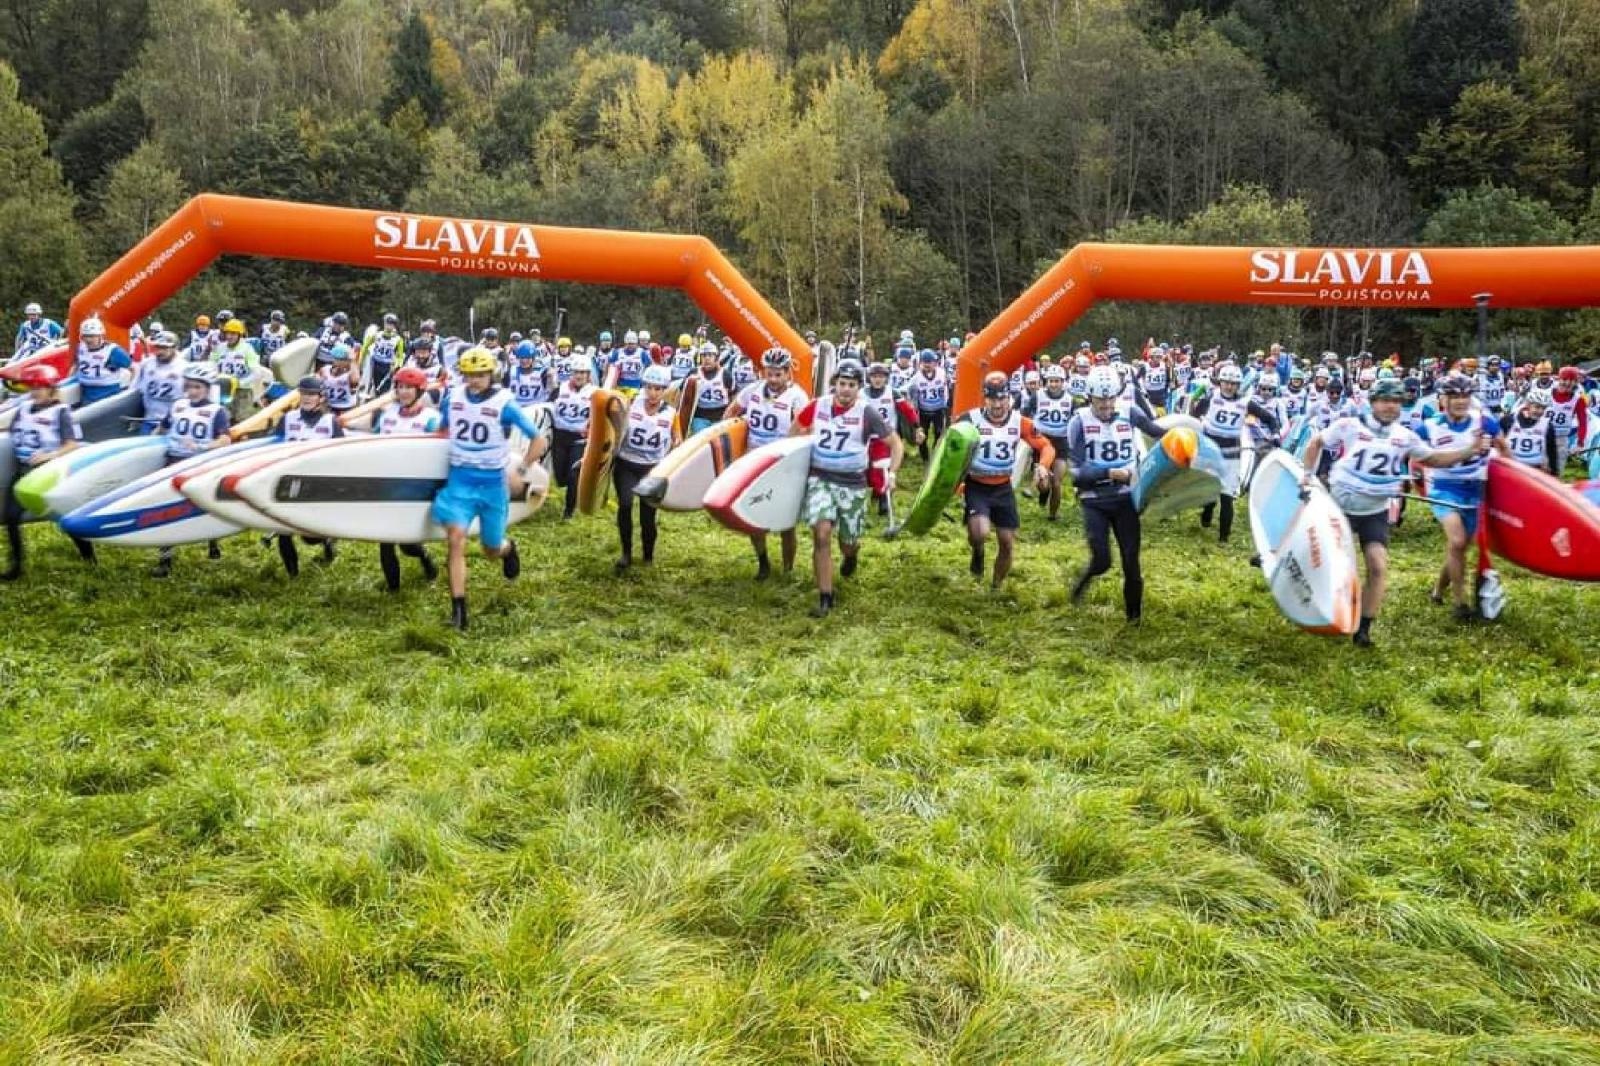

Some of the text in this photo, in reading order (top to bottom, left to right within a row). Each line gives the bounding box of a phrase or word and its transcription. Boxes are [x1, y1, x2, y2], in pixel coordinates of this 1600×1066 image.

[374, 214, 541, 259] SLAVIA
[1250, 249, 1433, 285] SLAVIA
[80, 361, 101, 377] 21
[701, 389, 724, 402] 43
[750, 410, 778, 431] 50
[1215, 410, 1240, 426] 67
[456, 419, 489, 444] 20
[630, 427, 661, 449] 54
[818, 428, 851, 452] 27
[1085, 439, 1132, 462] 185
[1509, 437, 1544, 453] 191
